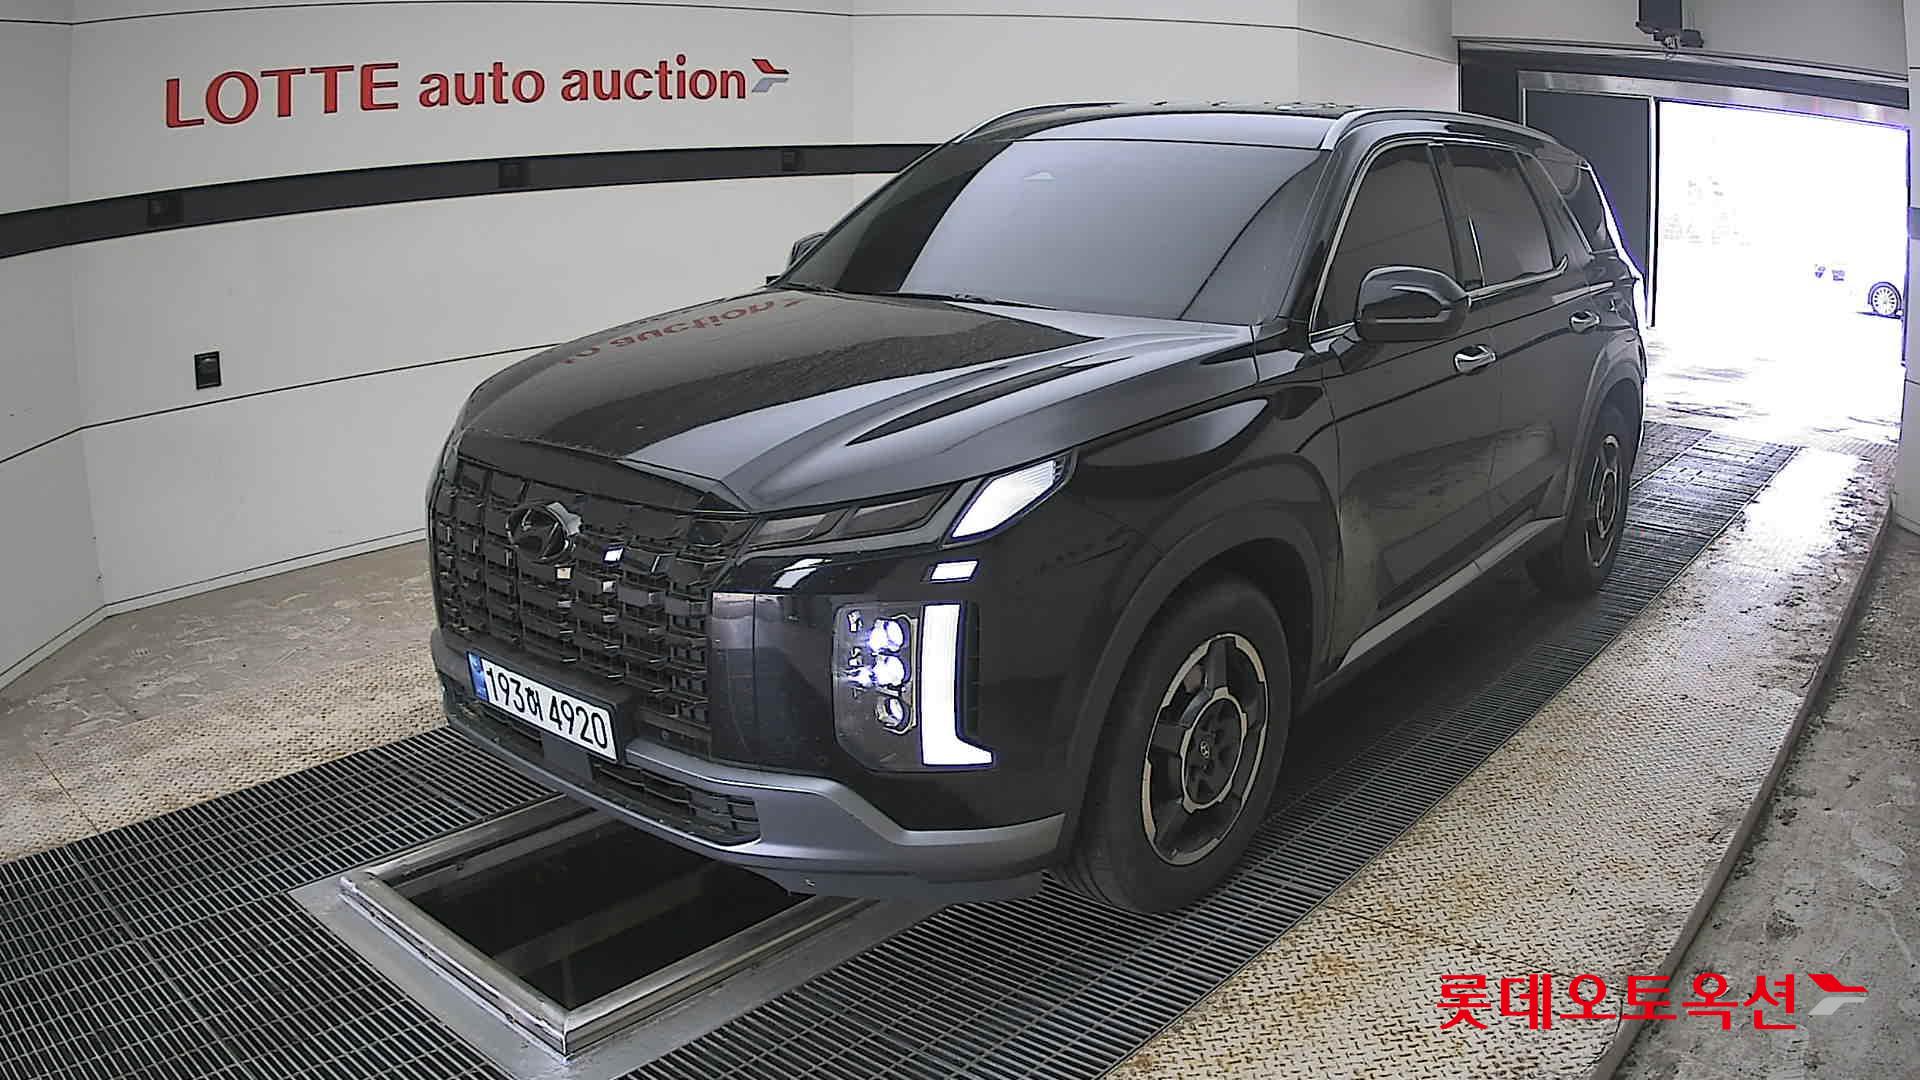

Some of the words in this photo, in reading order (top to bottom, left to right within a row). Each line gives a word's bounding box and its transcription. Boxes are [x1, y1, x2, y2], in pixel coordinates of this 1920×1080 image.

[166, 61, 400, 129] LOTTE
[418, 61, 546, 106] auto
[560, 53, 747, 101] auction
[549, 695, 608, 750] 4920
